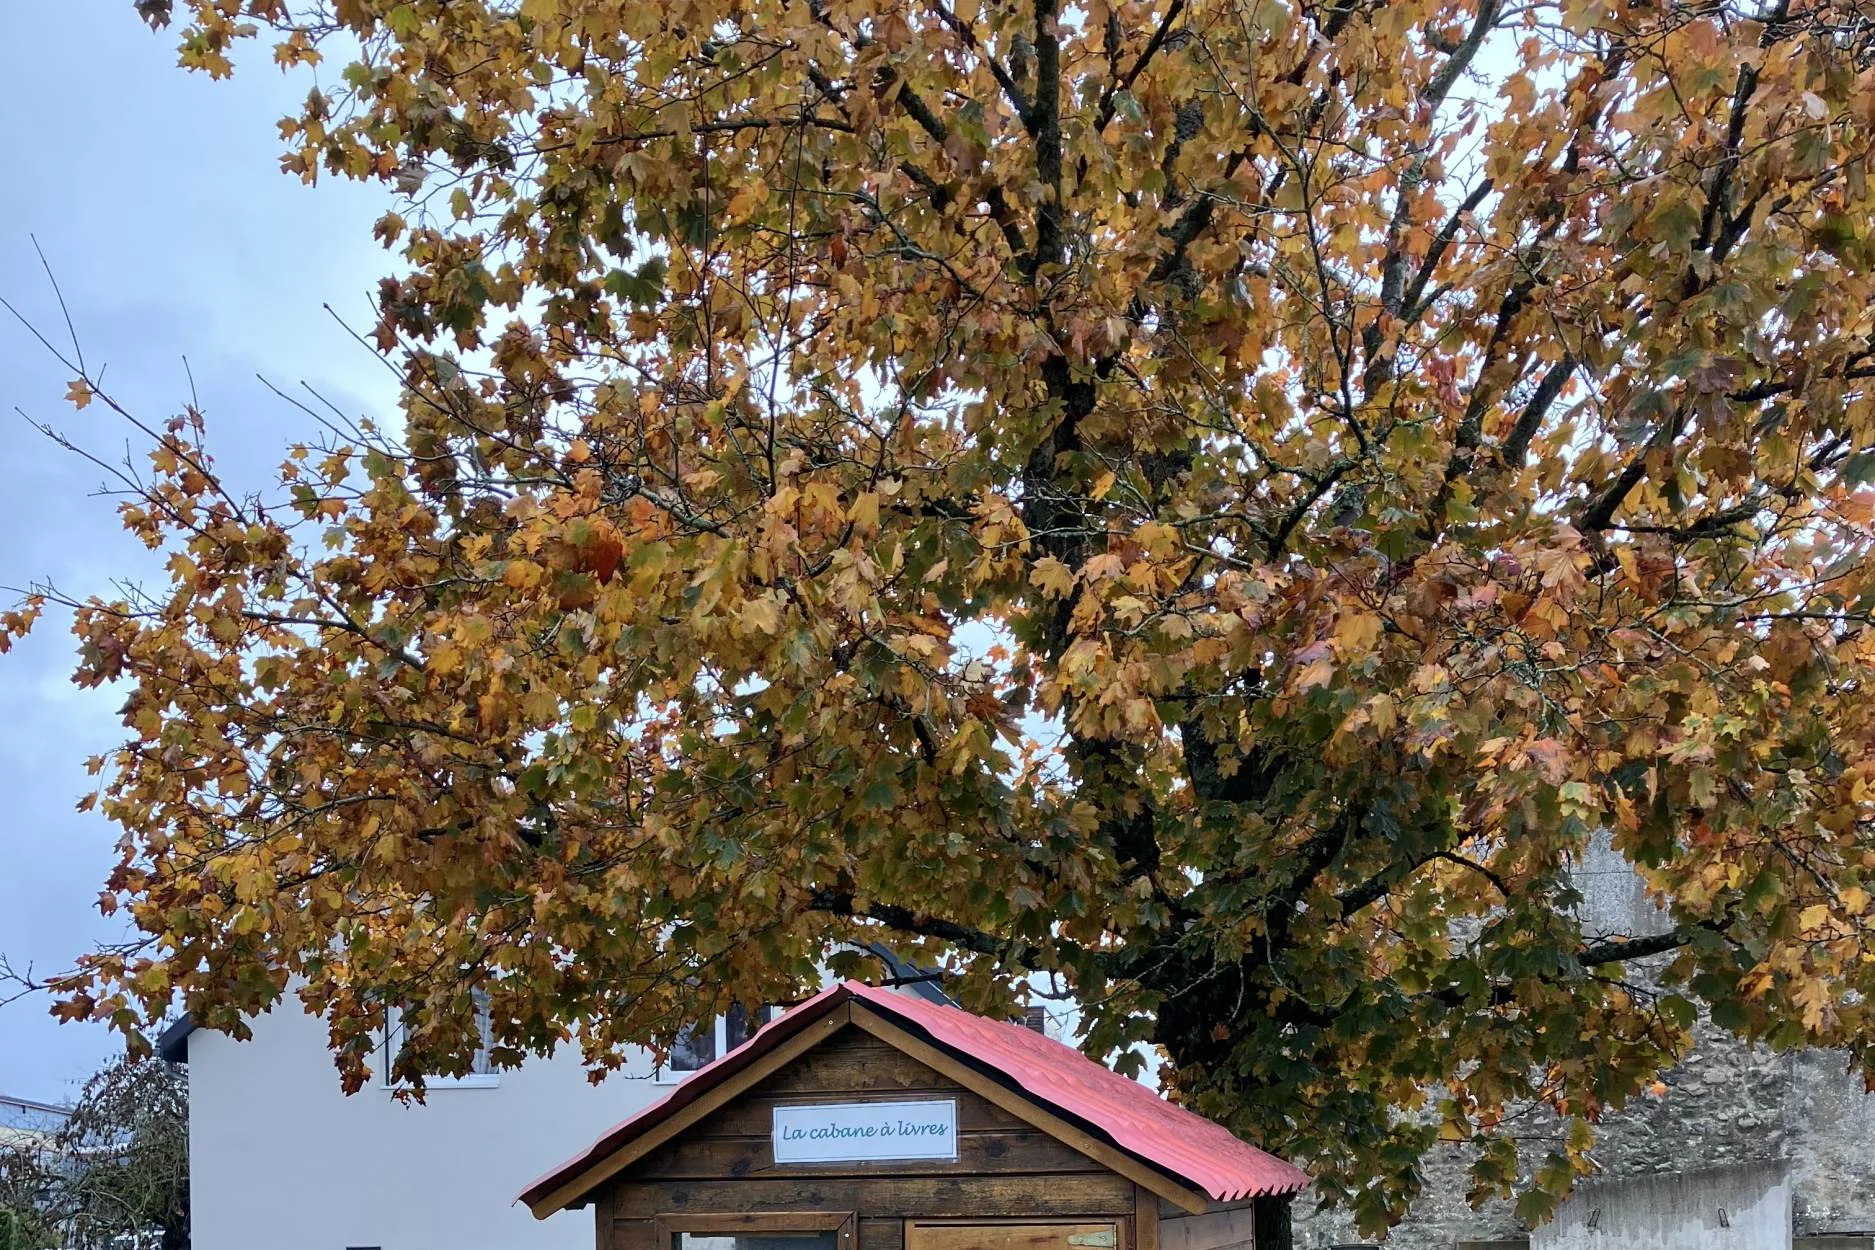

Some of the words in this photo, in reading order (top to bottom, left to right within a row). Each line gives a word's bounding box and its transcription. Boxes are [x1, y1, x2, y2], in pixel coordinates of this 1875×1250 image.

[783, 1125, 806, 1140] La
[809, 1123, 879, 1139] cabane
[880, 1122, 895, 1136] à
[897, 1121, 948, 1136] livres
